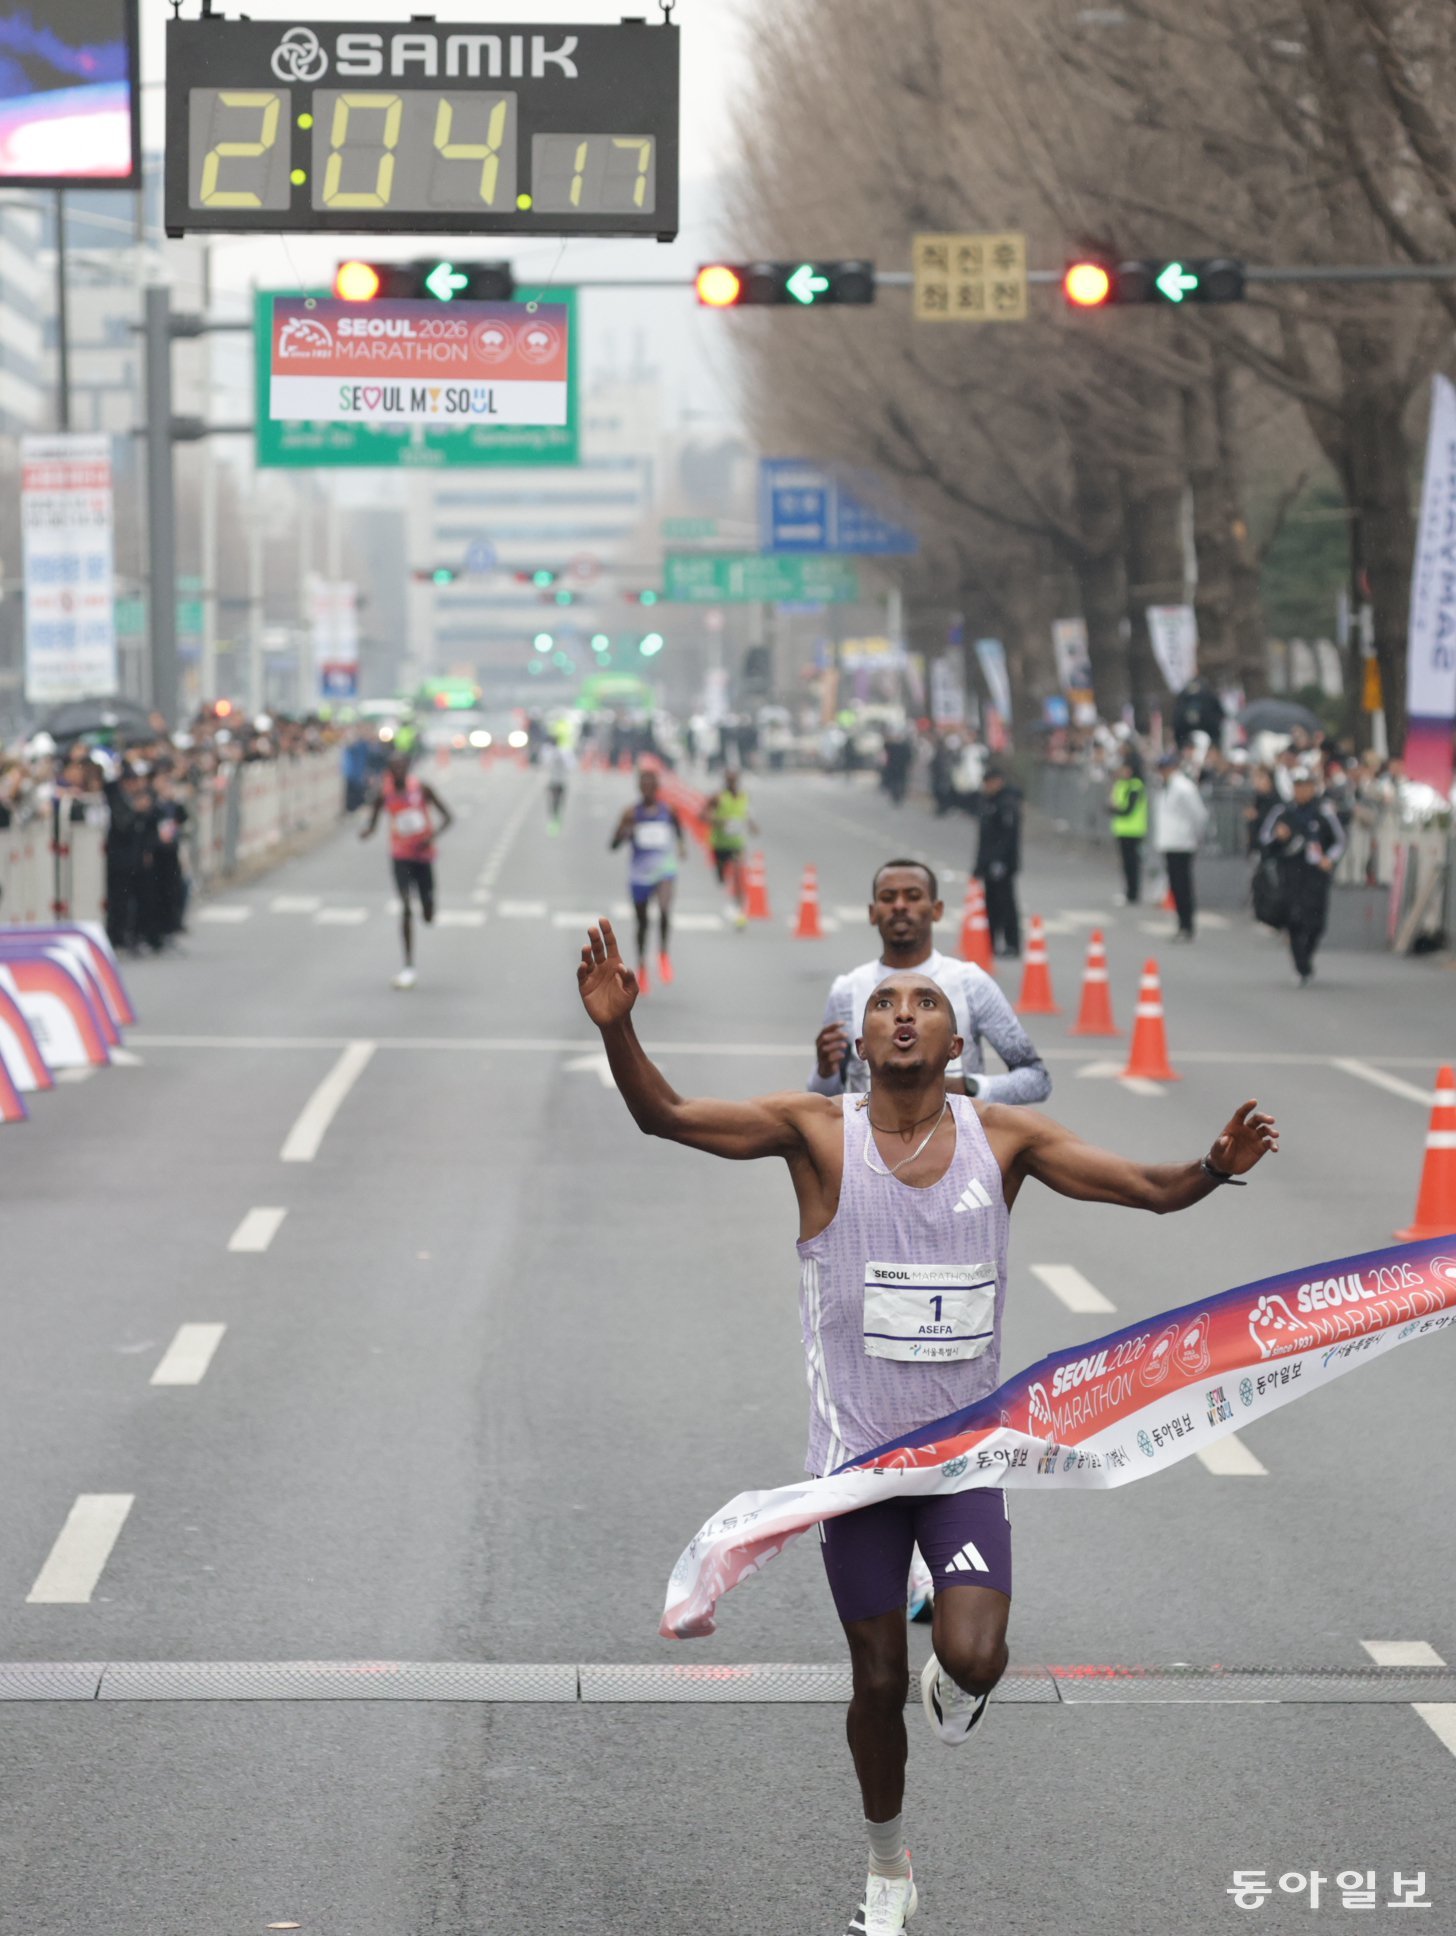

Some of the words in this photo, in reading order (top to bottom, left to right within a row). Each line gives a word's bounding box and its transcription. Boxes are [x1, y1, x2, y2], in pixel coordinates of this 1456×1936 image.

[336, 33, 579, 78] SAMIK
[337, 317, 417, 338] SEOUL
[419, 319, 469, 339] 2026
[335, 341, 469, 361] MARATHON
[874, 1270, 910, 1280] SEOUL
[912, 1272, 975, 1281] MARATHON
[1297, 1273, 1376, 1313] SEOUL
[1368, 1263, 1424, 1294] 2026
[929, 1295, 943, 1322] 1
[1308, 1286, 1446, 1344] MARATHON
[918, 1325, 953, 1334] ASEFA
[922, 1347, 959, 1357] 서울특별시
[1272, 1343, 1293, 1356] since
[1293, 1335, 1314, 1351] 1931
[1051, 1350, 1109, 1398] SEOUL
[1107, 1333, 1151, 1372] 2026
[1257, 1361, 1302, 1395] 동아일보
[1052, 1369, 1135, 1441] MARATHON
[1152, 1413, 1195, 1447] 동아일보
[976, 1447, 1029, 1469] 동아일보
